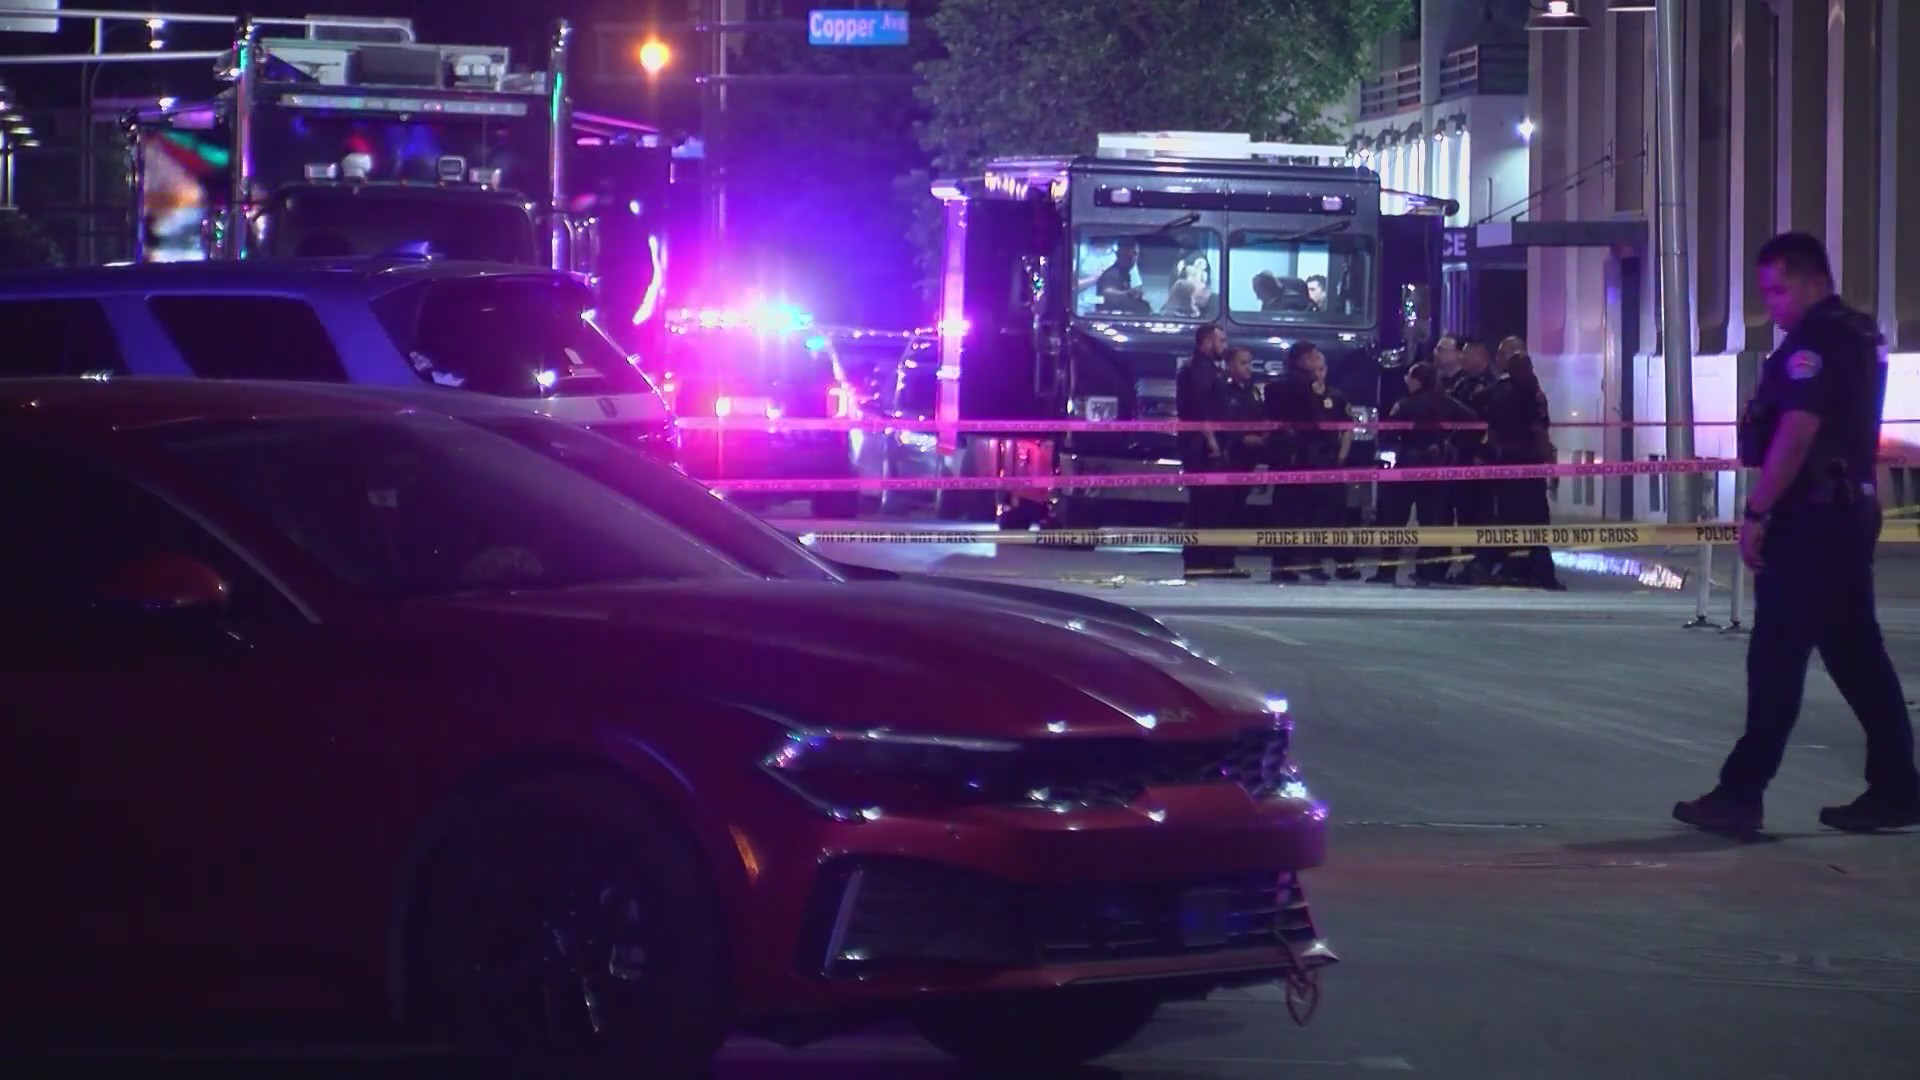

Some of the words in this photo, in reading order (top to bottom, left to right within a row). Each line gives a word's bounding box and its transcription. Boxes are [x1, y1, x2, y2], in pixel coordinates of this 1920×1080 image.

[810, 13, 876, 43] Copper
[910, 531, 932, 543] NOT
[937, 531, 977, 544] CROSS
[1036, 532, 1078, 545] POLICE
[1082, 532, 1107, 545] LINE
[1111, 532, 1128, 545] DO
[1132, 532, 1154, 544] NOT
[1159, 531, 1199, 544] CROSS
[1256, 531, 1299, 545] POLICE
[1302, 531, 1328, 545] LINE
[1332, 531, 1349, 545] DO
[1352, 530, 1376, 545] NOT
[1379, 530, 1419, 545] CROSS
[1476, 529, 1519, 544] POLICE
[1523, 529, 1549, 543] LINE
[1553, 529, 1569, 543] DO
[1573, 528, 1596, 543] NOT
[1600, 528, 1639, 543] CROSS
[1696, 526, 1739, 541] POLICE
